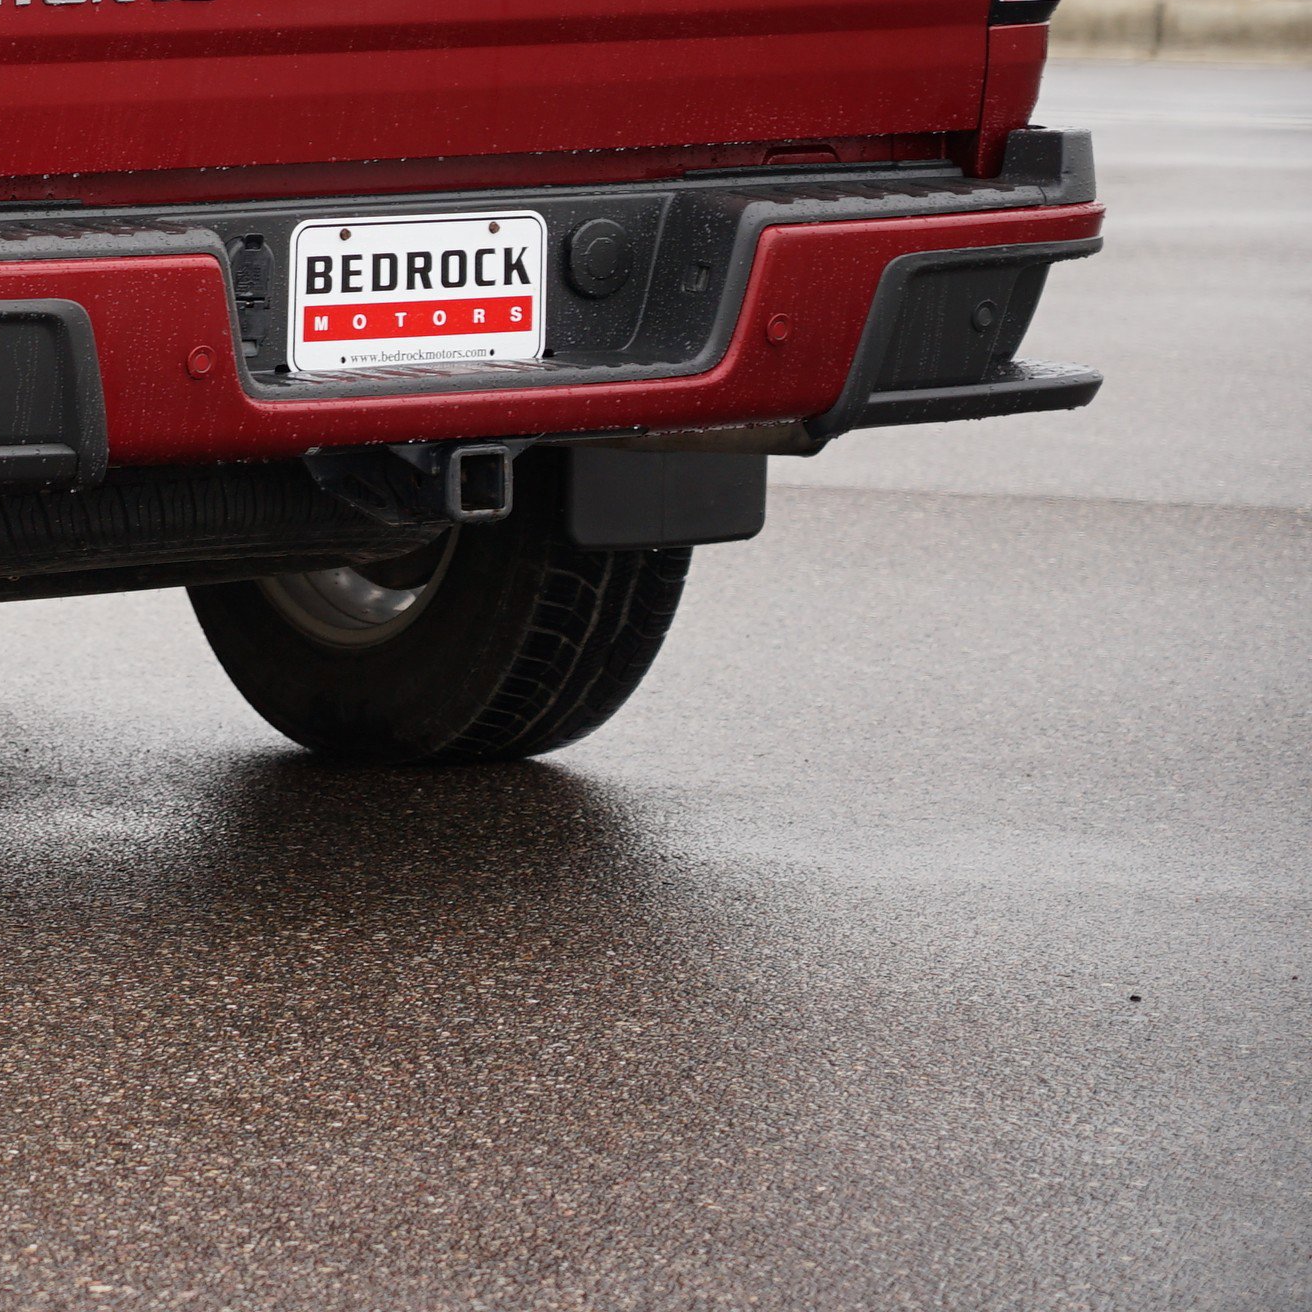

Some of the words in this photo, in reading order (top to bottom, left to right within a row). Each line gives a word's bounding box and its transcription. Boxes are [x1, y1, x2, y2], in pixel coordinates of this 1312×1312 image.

[305, 246, 532, 295] BEDROCK
[313, 306, 523, 332] MOTORS
[350, 347, 487, 364] www.bedrockmotors.com
